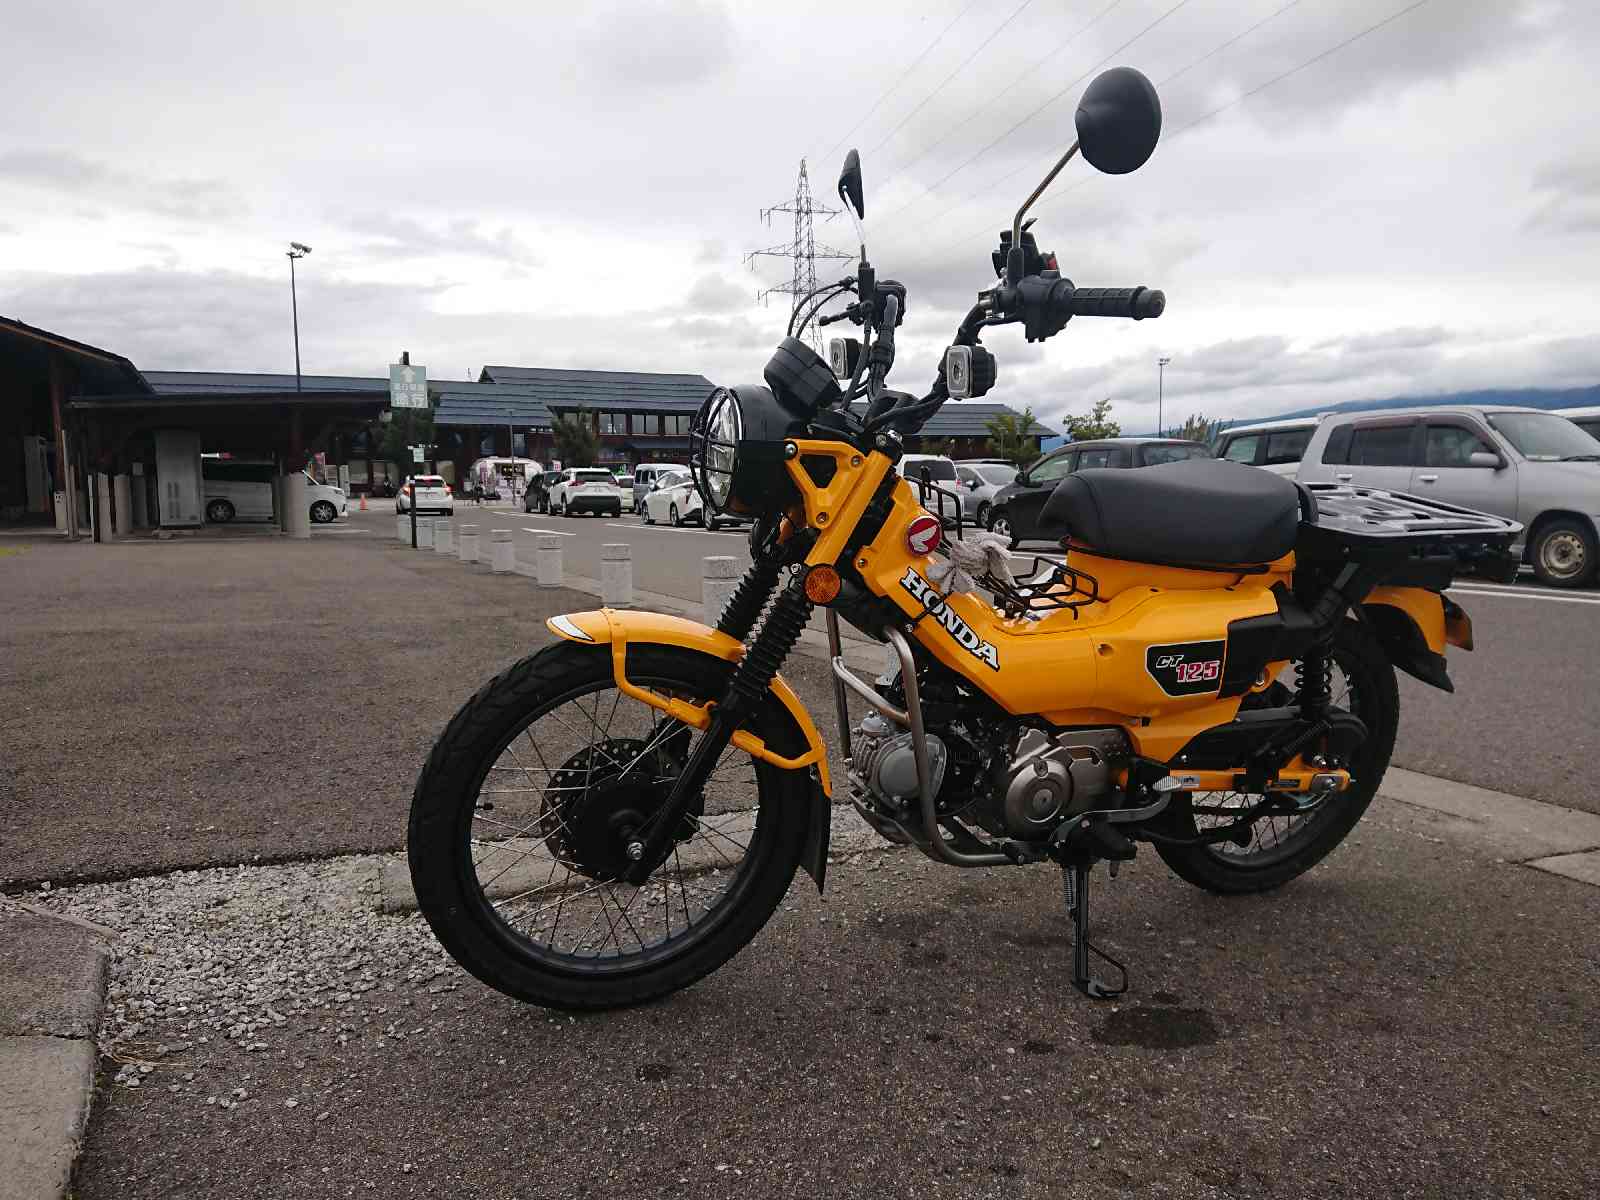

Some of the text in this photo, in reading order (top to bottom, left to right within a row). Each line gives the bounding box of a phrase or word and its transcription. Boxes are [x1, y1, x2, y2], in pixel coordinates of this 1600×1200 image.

[900, 567, 1000, 671] HONDA
[1156, 655, 1220, 682] CT 125
